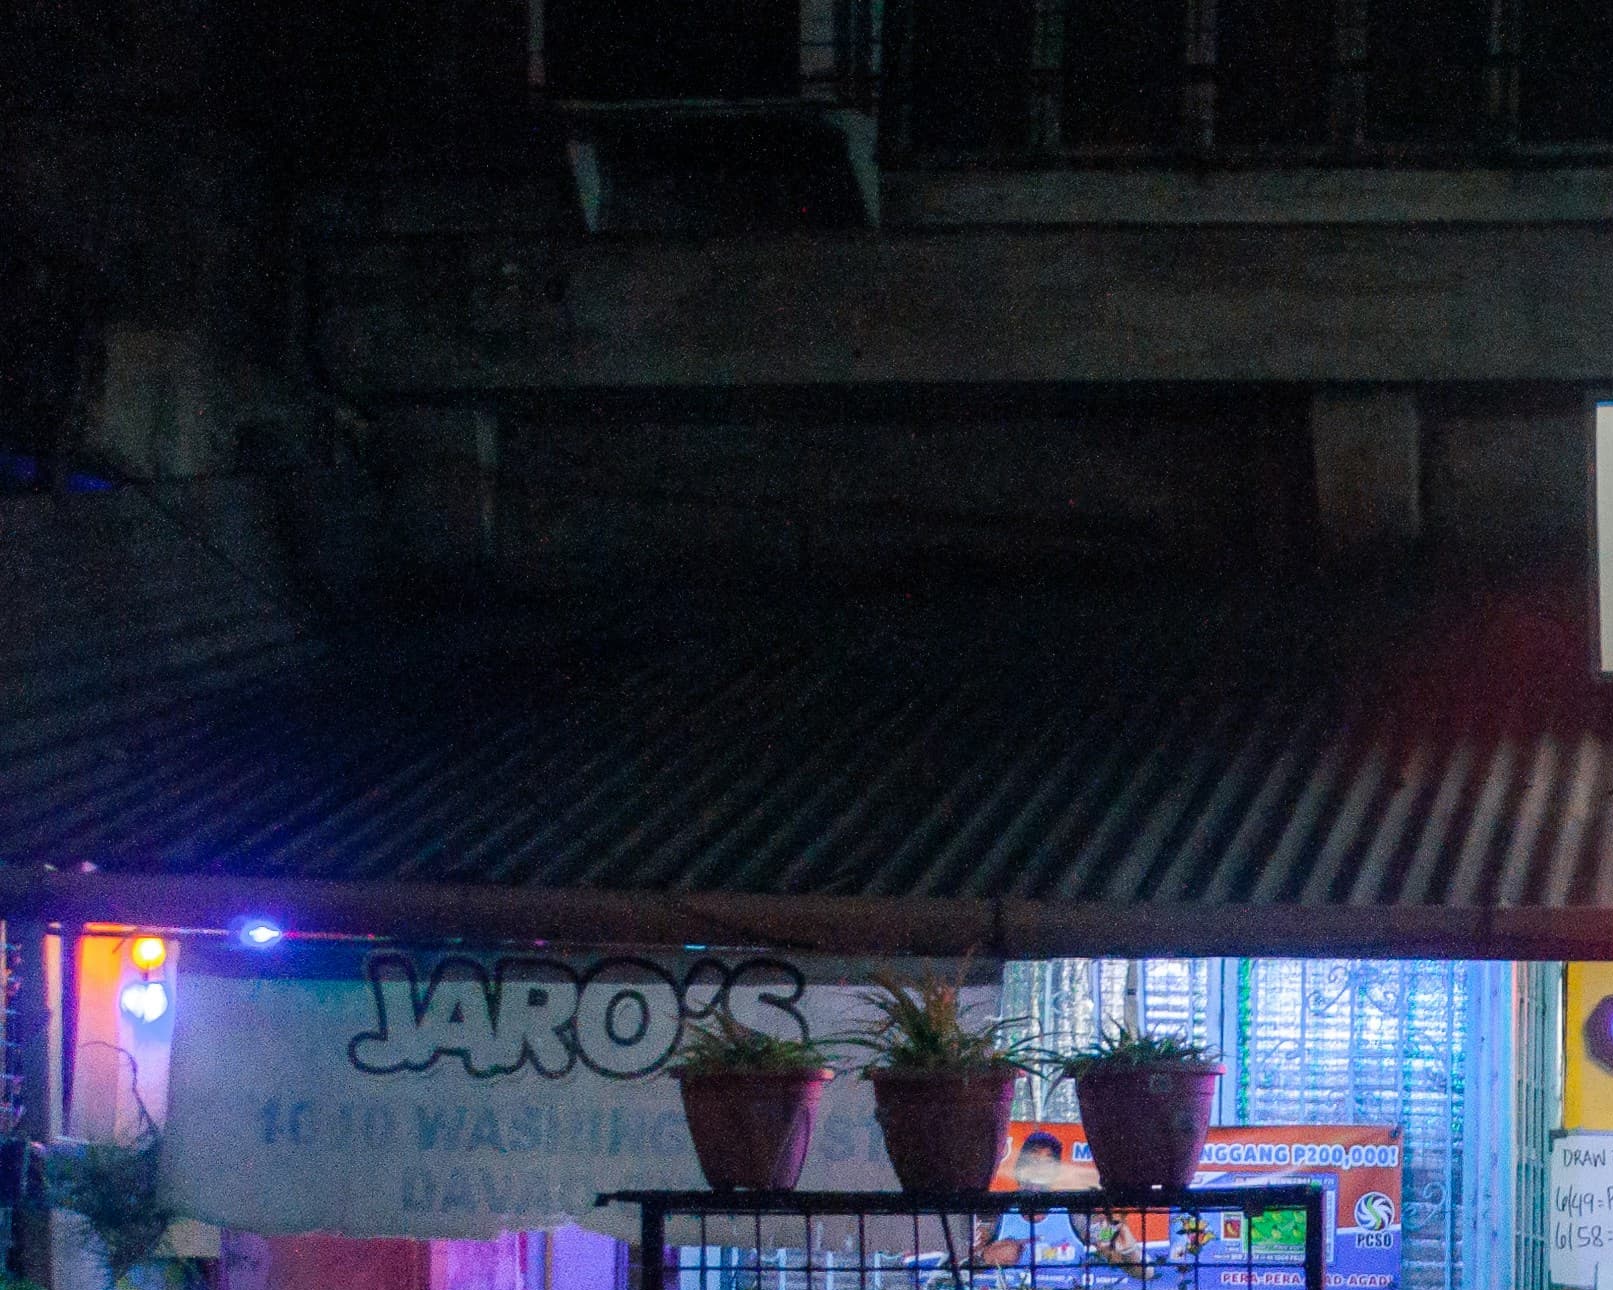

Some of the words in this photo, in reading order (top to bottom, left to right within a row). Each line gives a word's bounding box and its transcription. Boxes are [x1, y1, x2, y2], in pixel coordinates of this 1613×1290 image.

[348, 950, 810, 1079] JARO'S
[1200, 1142, 1289, 1167] NGGANG
[1293, 1142, 1398, 1171] P200,000!
[1563, 1148, 1606, 1168] DRAW
[1356, 1231, 1394, 1248] PCSO
